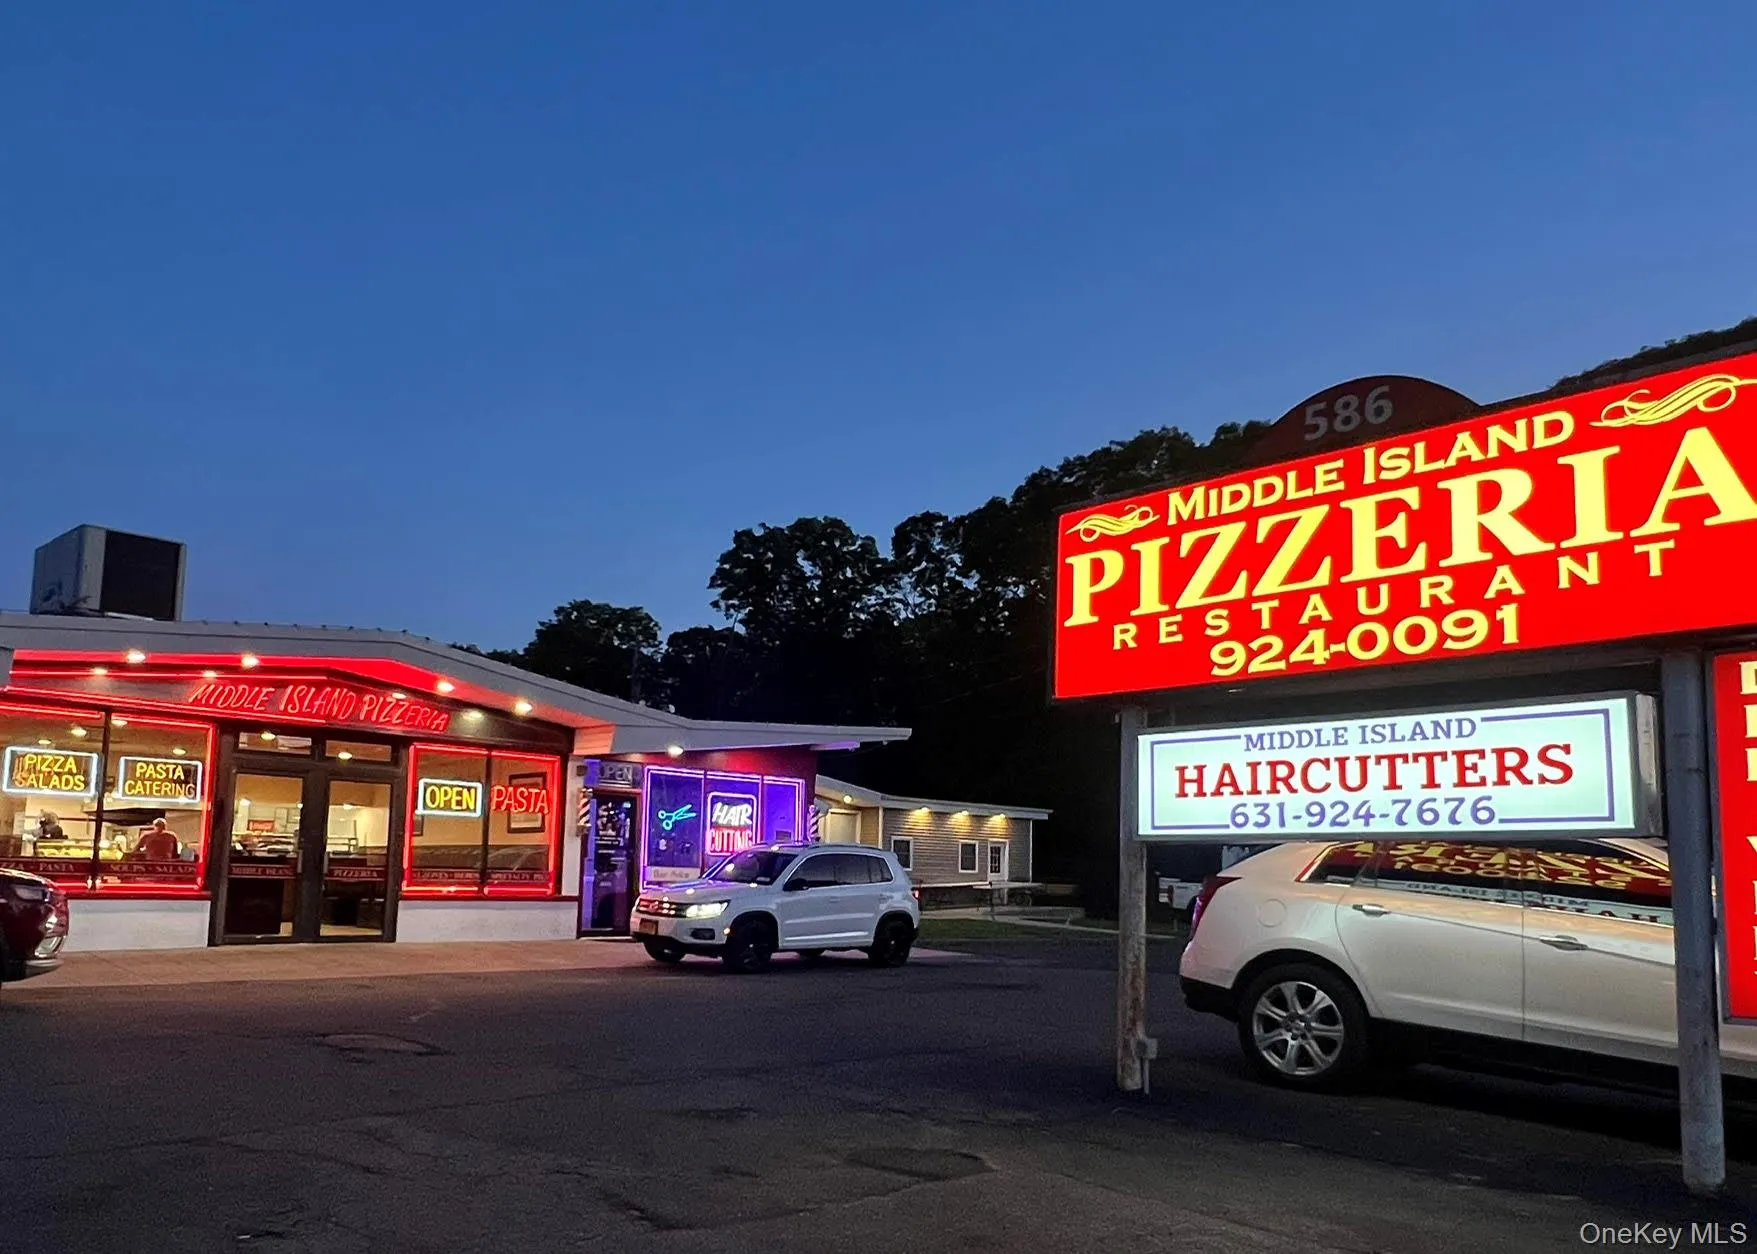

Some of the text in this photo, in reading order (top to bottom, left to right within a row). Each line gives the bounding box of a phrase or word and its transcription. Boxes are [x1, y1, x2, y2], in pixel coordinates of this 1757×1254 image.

[1303, 385, 1394, 441] 586
[1166, 410, 1575, 525] MIDDLE ISLAND
[1063, 426, 1757, 628] PIZZERIA
[1112, 539, 1676, 651] RESTAURANT
[1209, 603, 1520, 677] 924-0091
[188, 683, 449, 731] MIDDLE ISLAND PIZZERIA
[1243, 717, 1477, 752] MIDDLE ISLAND
[23, 753, 77, 774] PIZZA
[136, 762, 185, 780] PASTA
[1174, 743, 1575, 798] HAIRCUTTERS
[14, 773, 85, 791] SALADS
[124, 780, 195, 798] CATERING
[425, 785, 476, 810] OPEN
[491, 785, 549, 815] PASTA
[711, 801, 753, 826] HAIR
[1229, 795, 1497, 828] 631-924-7676
[39, 862, 74, 872] PASTA
